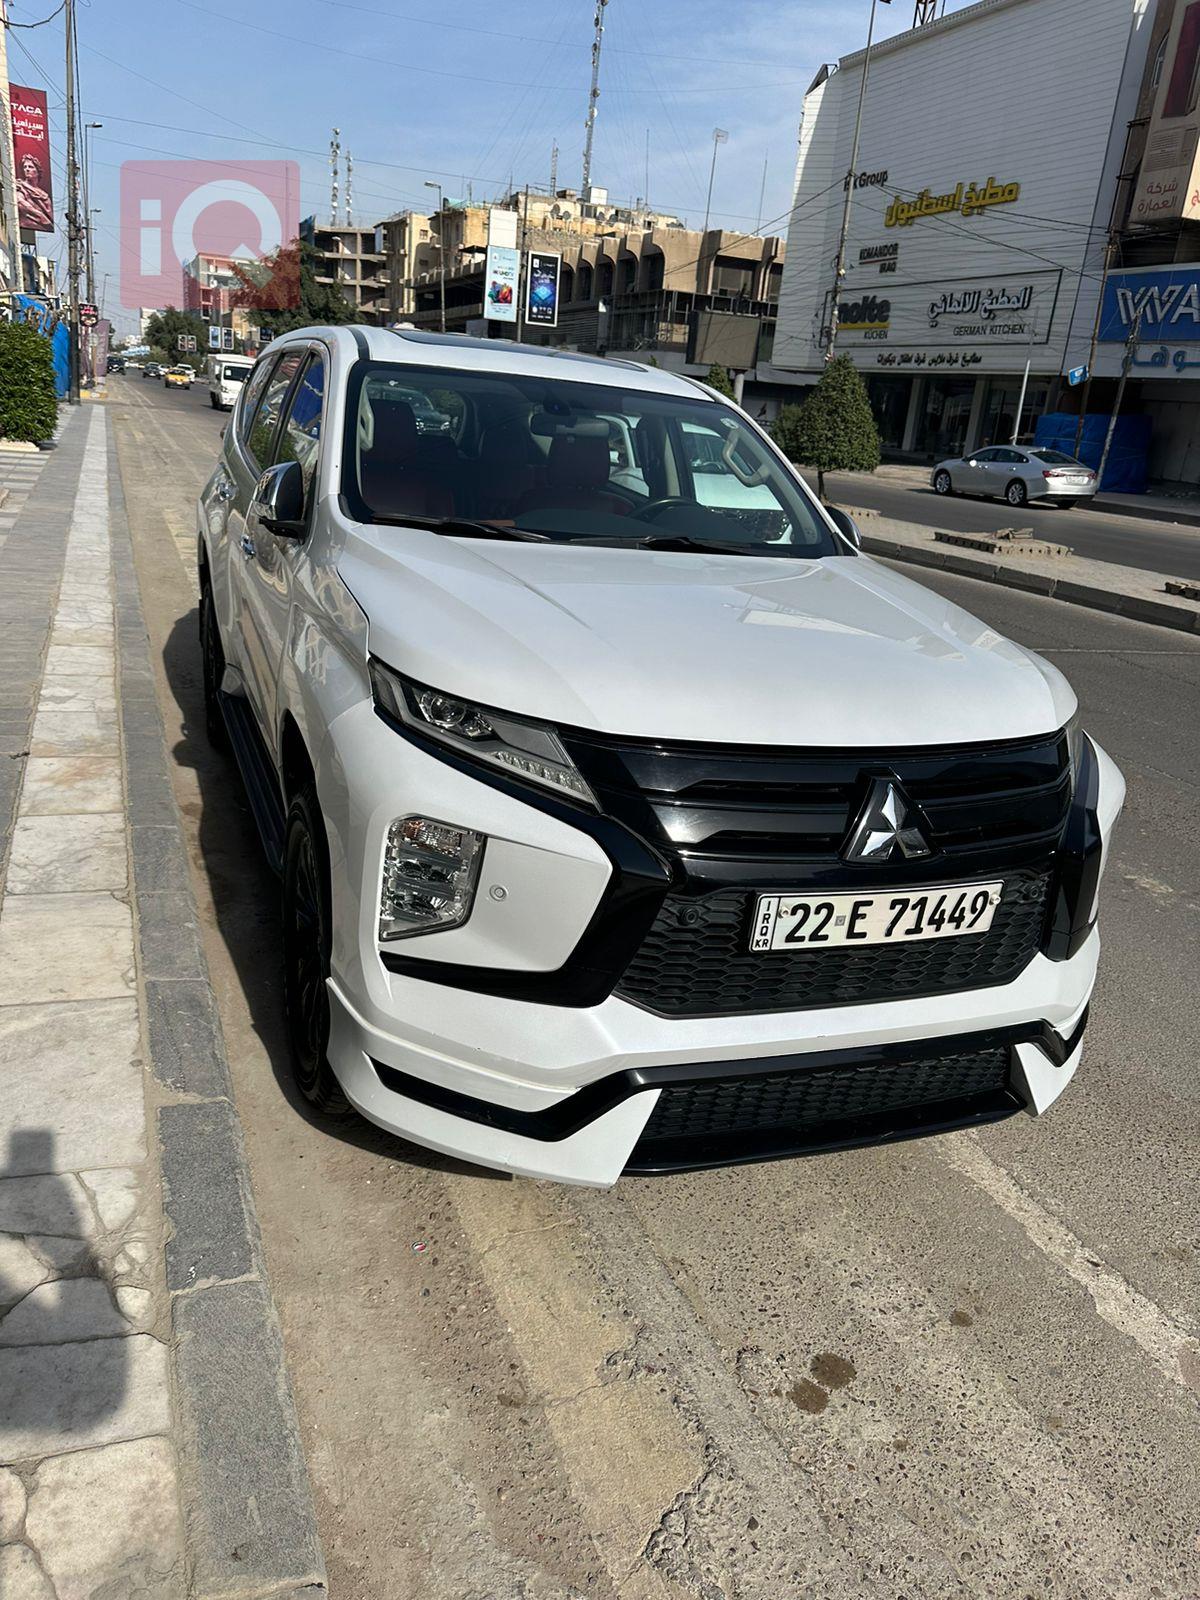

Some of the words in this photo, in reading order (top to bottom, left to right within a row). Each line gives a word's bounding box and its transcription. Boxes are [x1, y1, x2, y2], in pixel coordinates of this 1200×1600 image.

[859, 170, 888, 188] Group
[1147, 177, 1177, 195] شركة
[961, 177, 1019, 216] مطبخ
[1137, 195, 1178, 215] العمارة
[838, 295, 890, 323] nolte
[980, 286, 1033, 320] المطبخ
[953, 326, 987, 336] GERMAN
[989, 324, 1025, 335] KITCHEN
[785, 902, 834, 943] 22
[846, 900, 873, 939] E
[885, 890, 989, 937] 71449
[754, 939, 769, 949] KR
